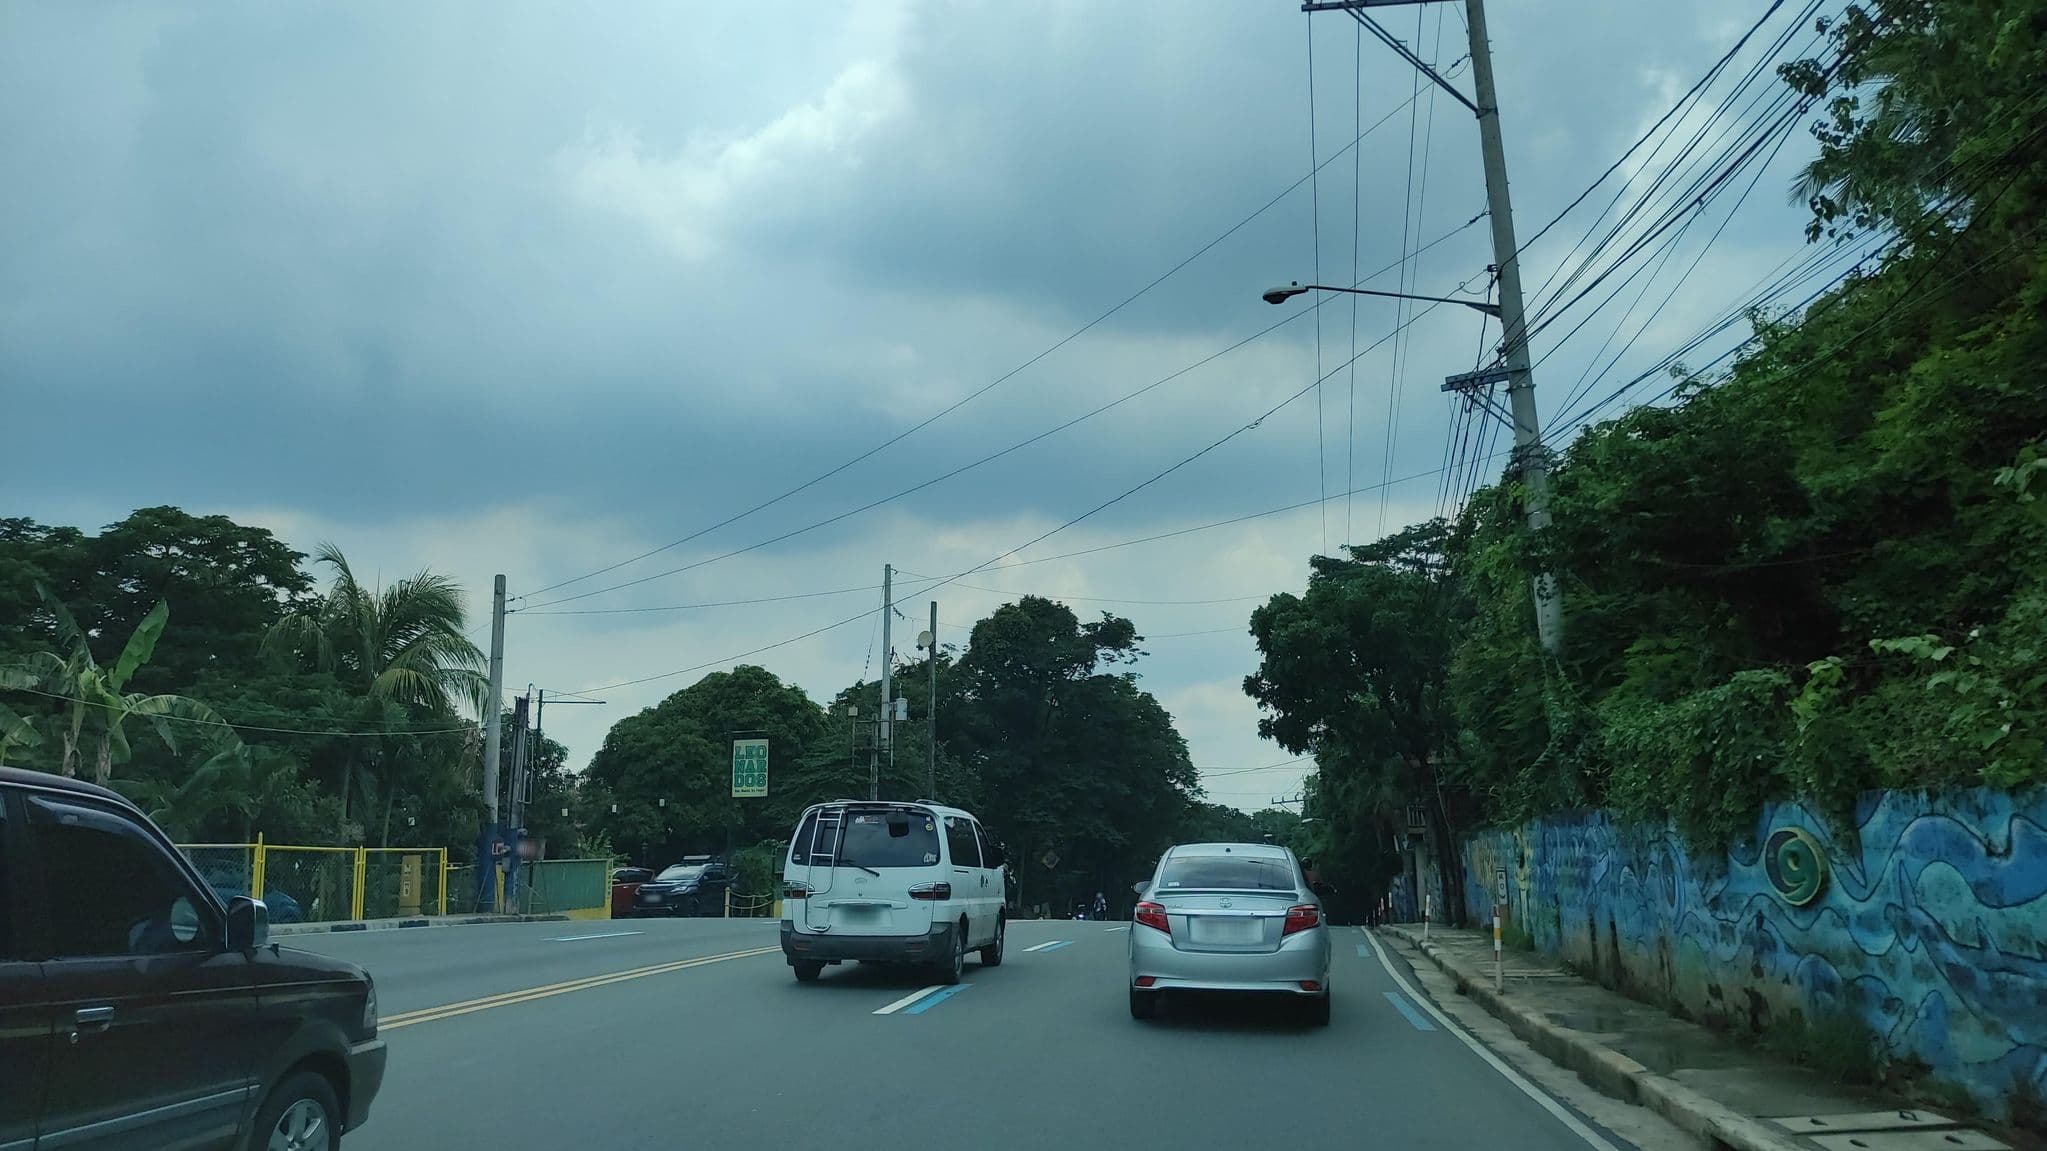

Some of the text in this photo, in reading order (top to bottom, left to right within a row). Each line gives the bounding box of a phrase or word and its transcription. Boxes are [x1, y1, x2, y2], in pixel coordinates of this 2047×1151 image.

[735, 745, 767, 759] LEO
[735, 760, 767, 773] NAR
[734, 773, 766, 787] DOS
